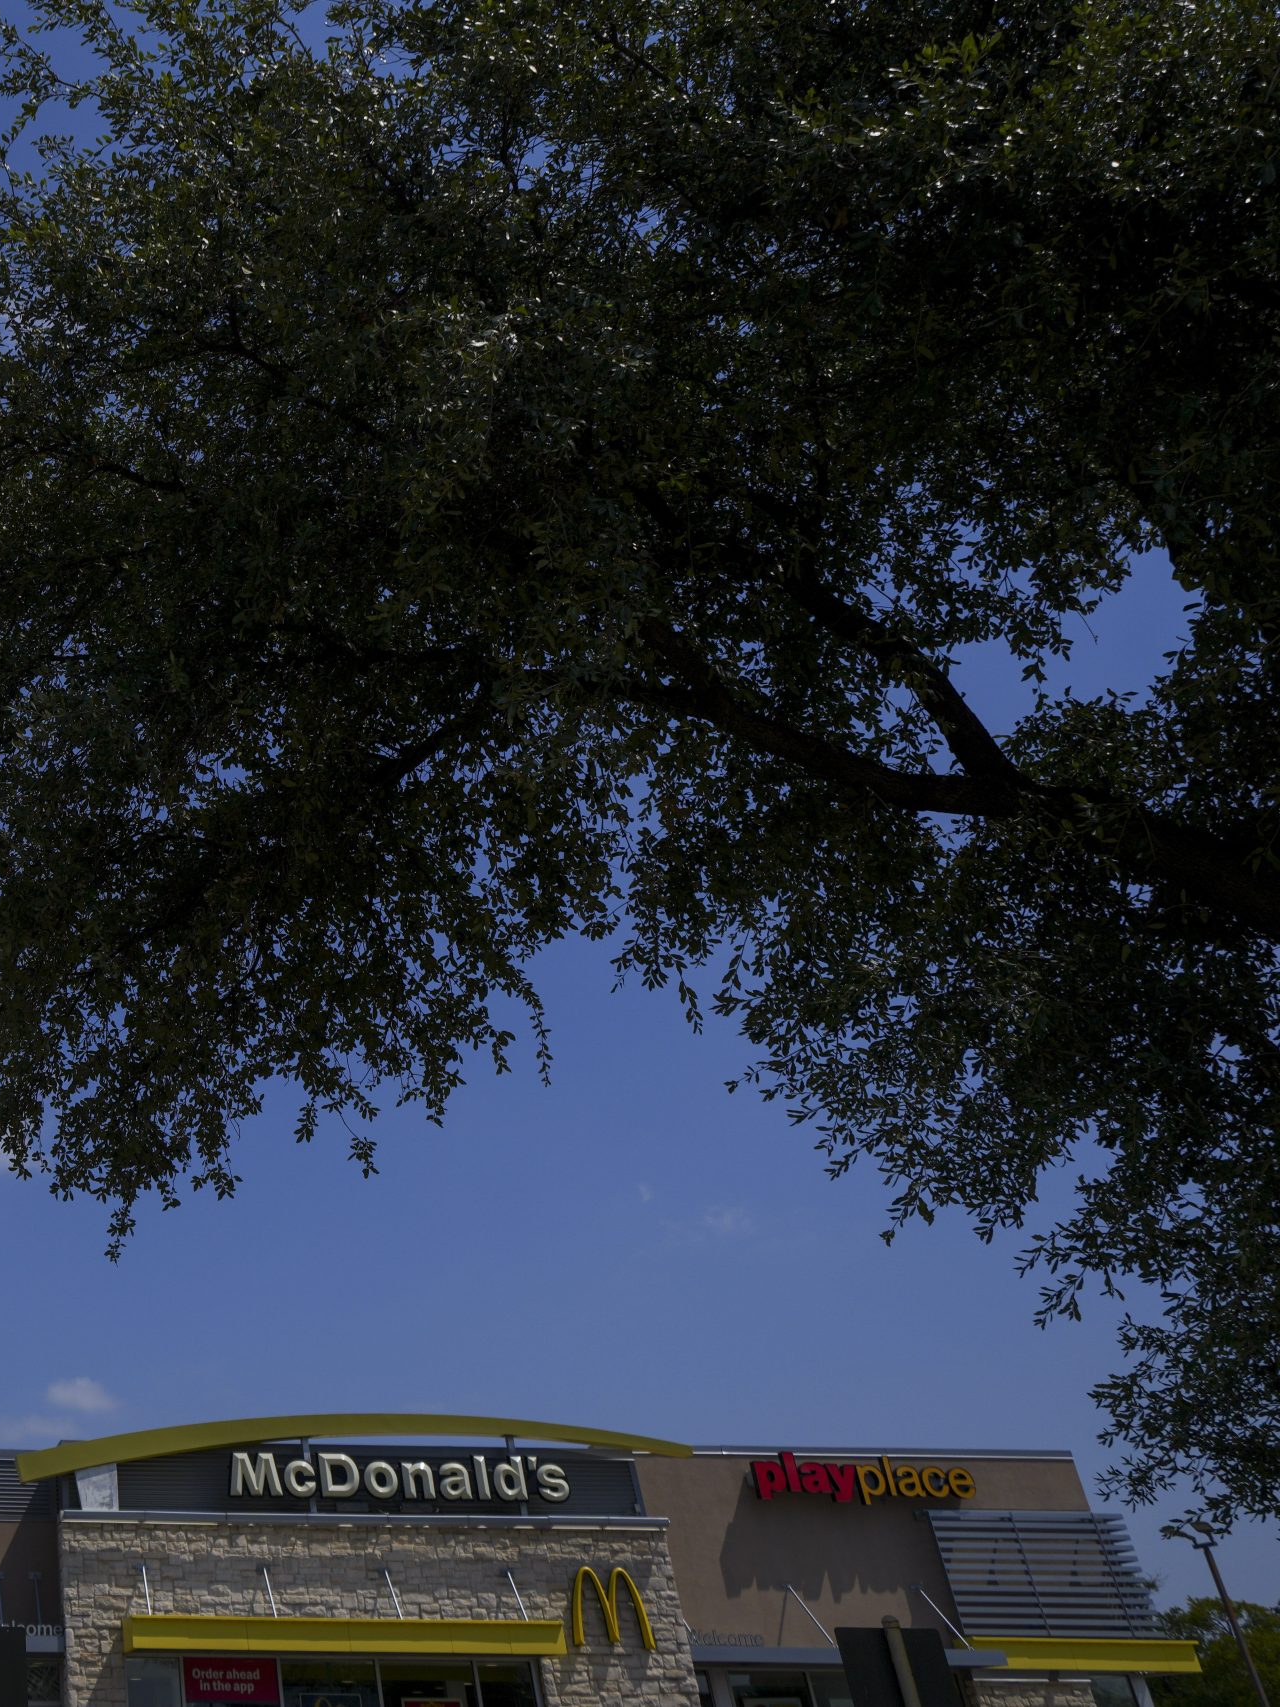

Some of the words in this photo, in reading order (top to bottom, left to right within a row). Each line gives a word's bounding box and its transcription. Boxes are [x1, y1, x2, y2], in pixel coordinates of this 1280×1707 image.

[229, 1452, 570, 1501] McDonald's
[191, 1667, 224, 1680] Order
[226, 1667, 260, 1680] ahead
[200, 1680, 210, 1691] in
[213, 1681, 231, 1692] the
[233, 1683, 254, 1694] app
